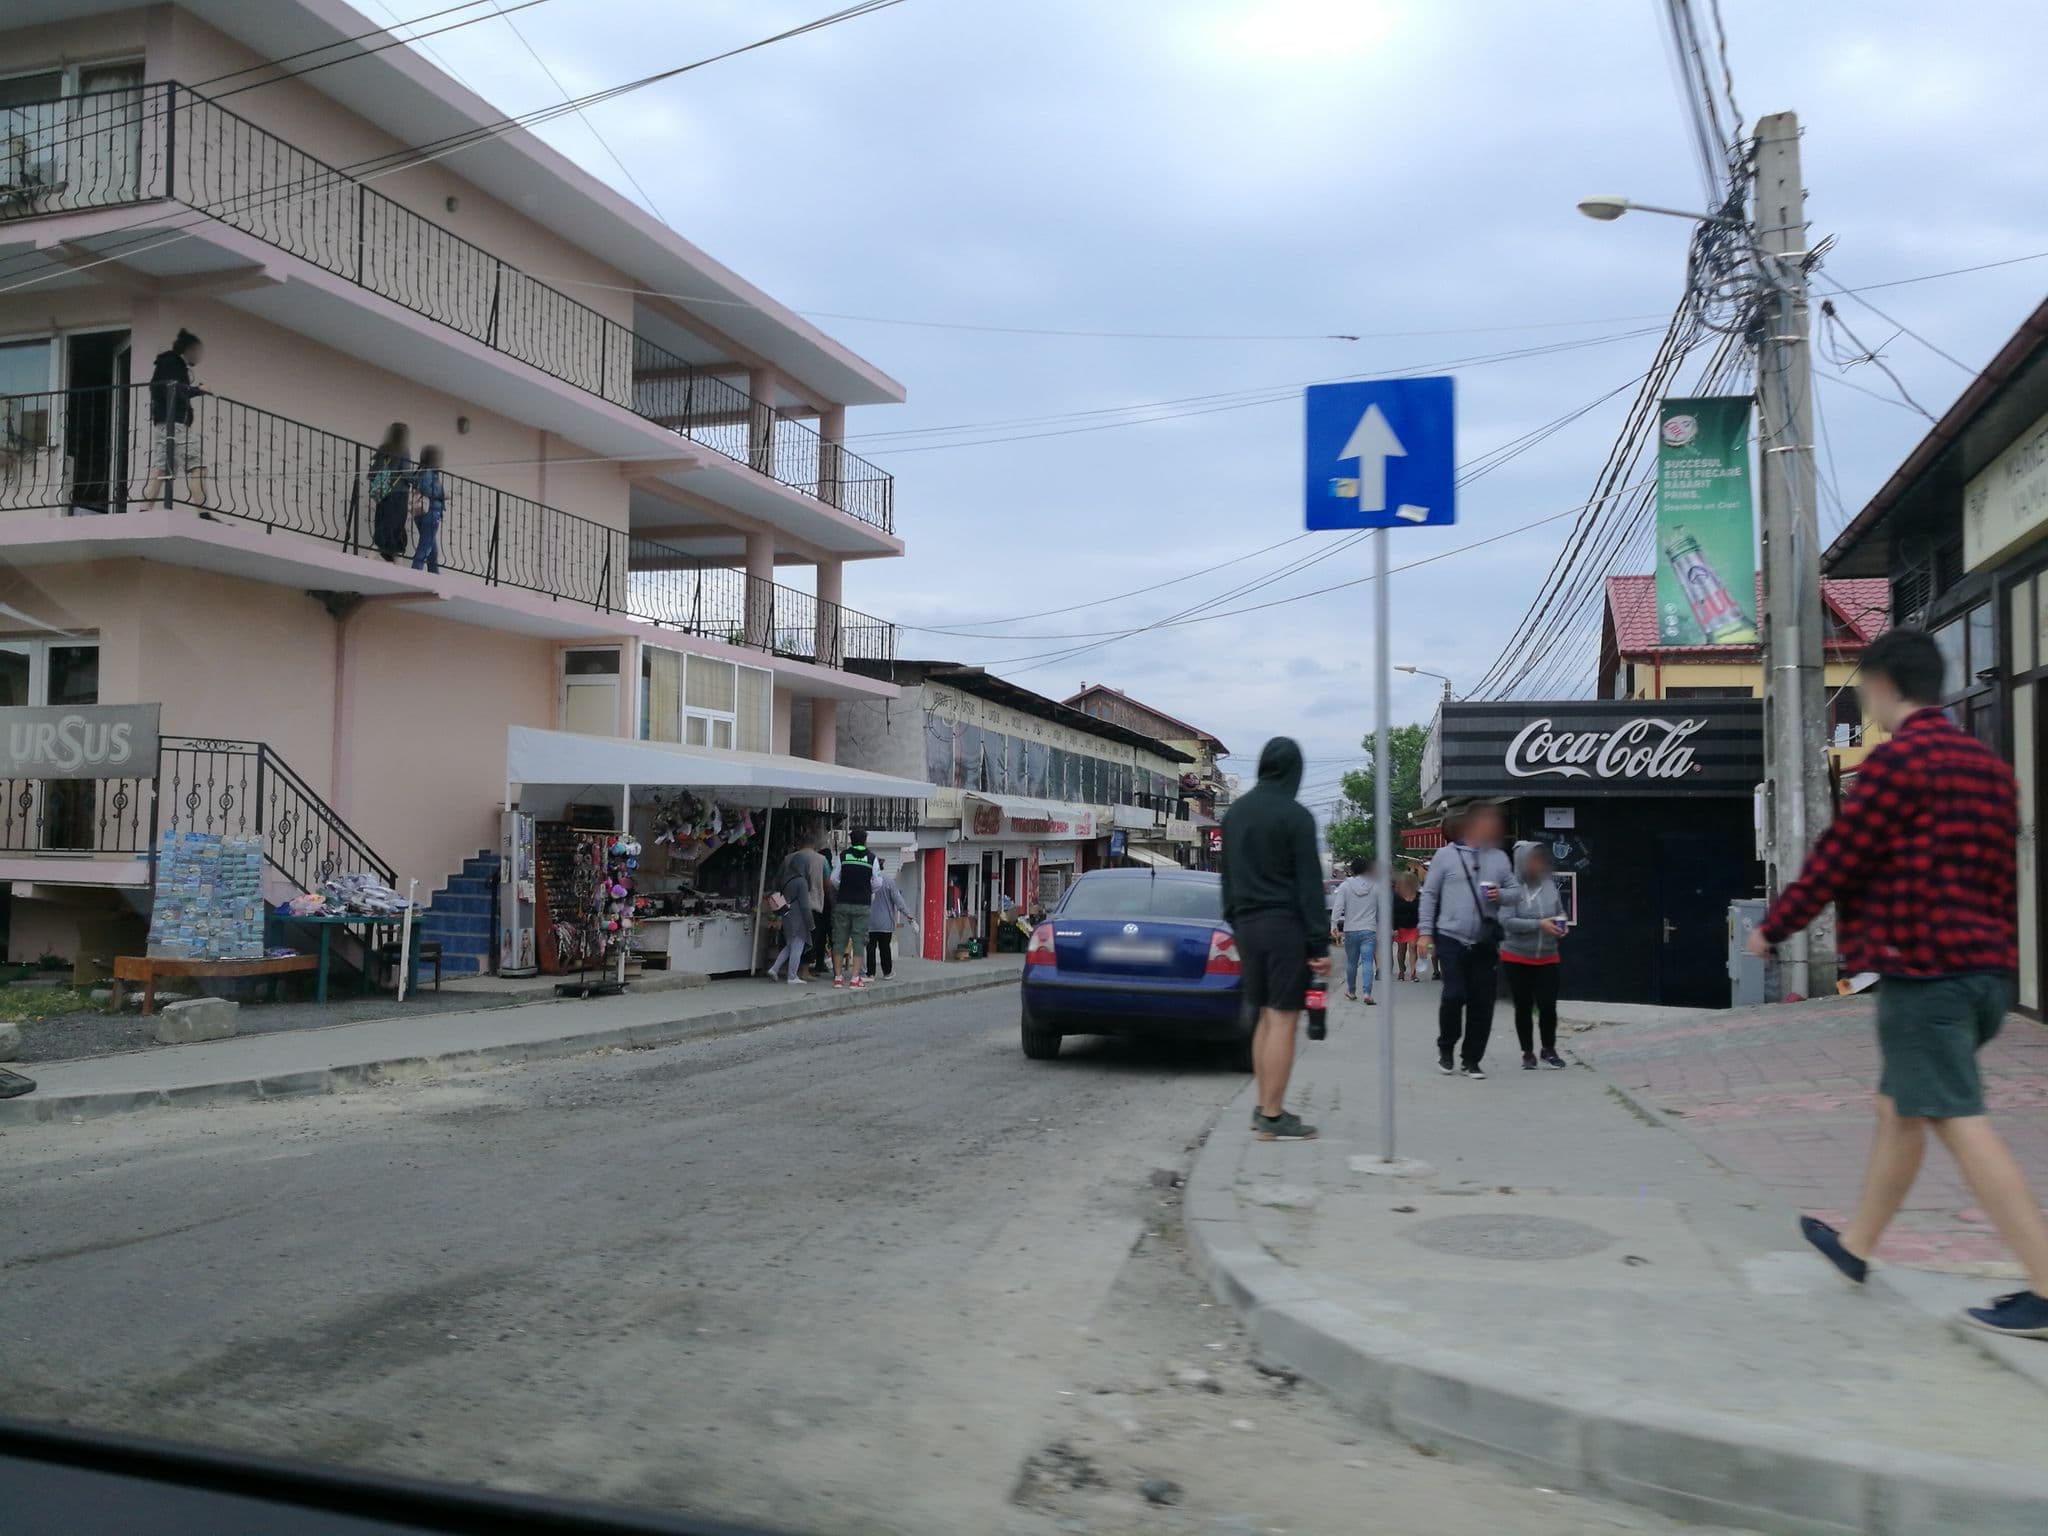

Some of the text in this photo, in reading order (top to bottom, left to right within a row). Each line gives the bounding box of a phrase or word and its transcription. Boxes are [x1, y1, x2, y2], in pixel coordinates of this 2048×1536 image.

[1664, 458, 1722, 469] SUCCESUL
[1664, 467, 1742, 479] ESTE FIECARE
[9, 714, 133, 773] URSUS
[1504, 718, 1708, 778] Coca-Cola
